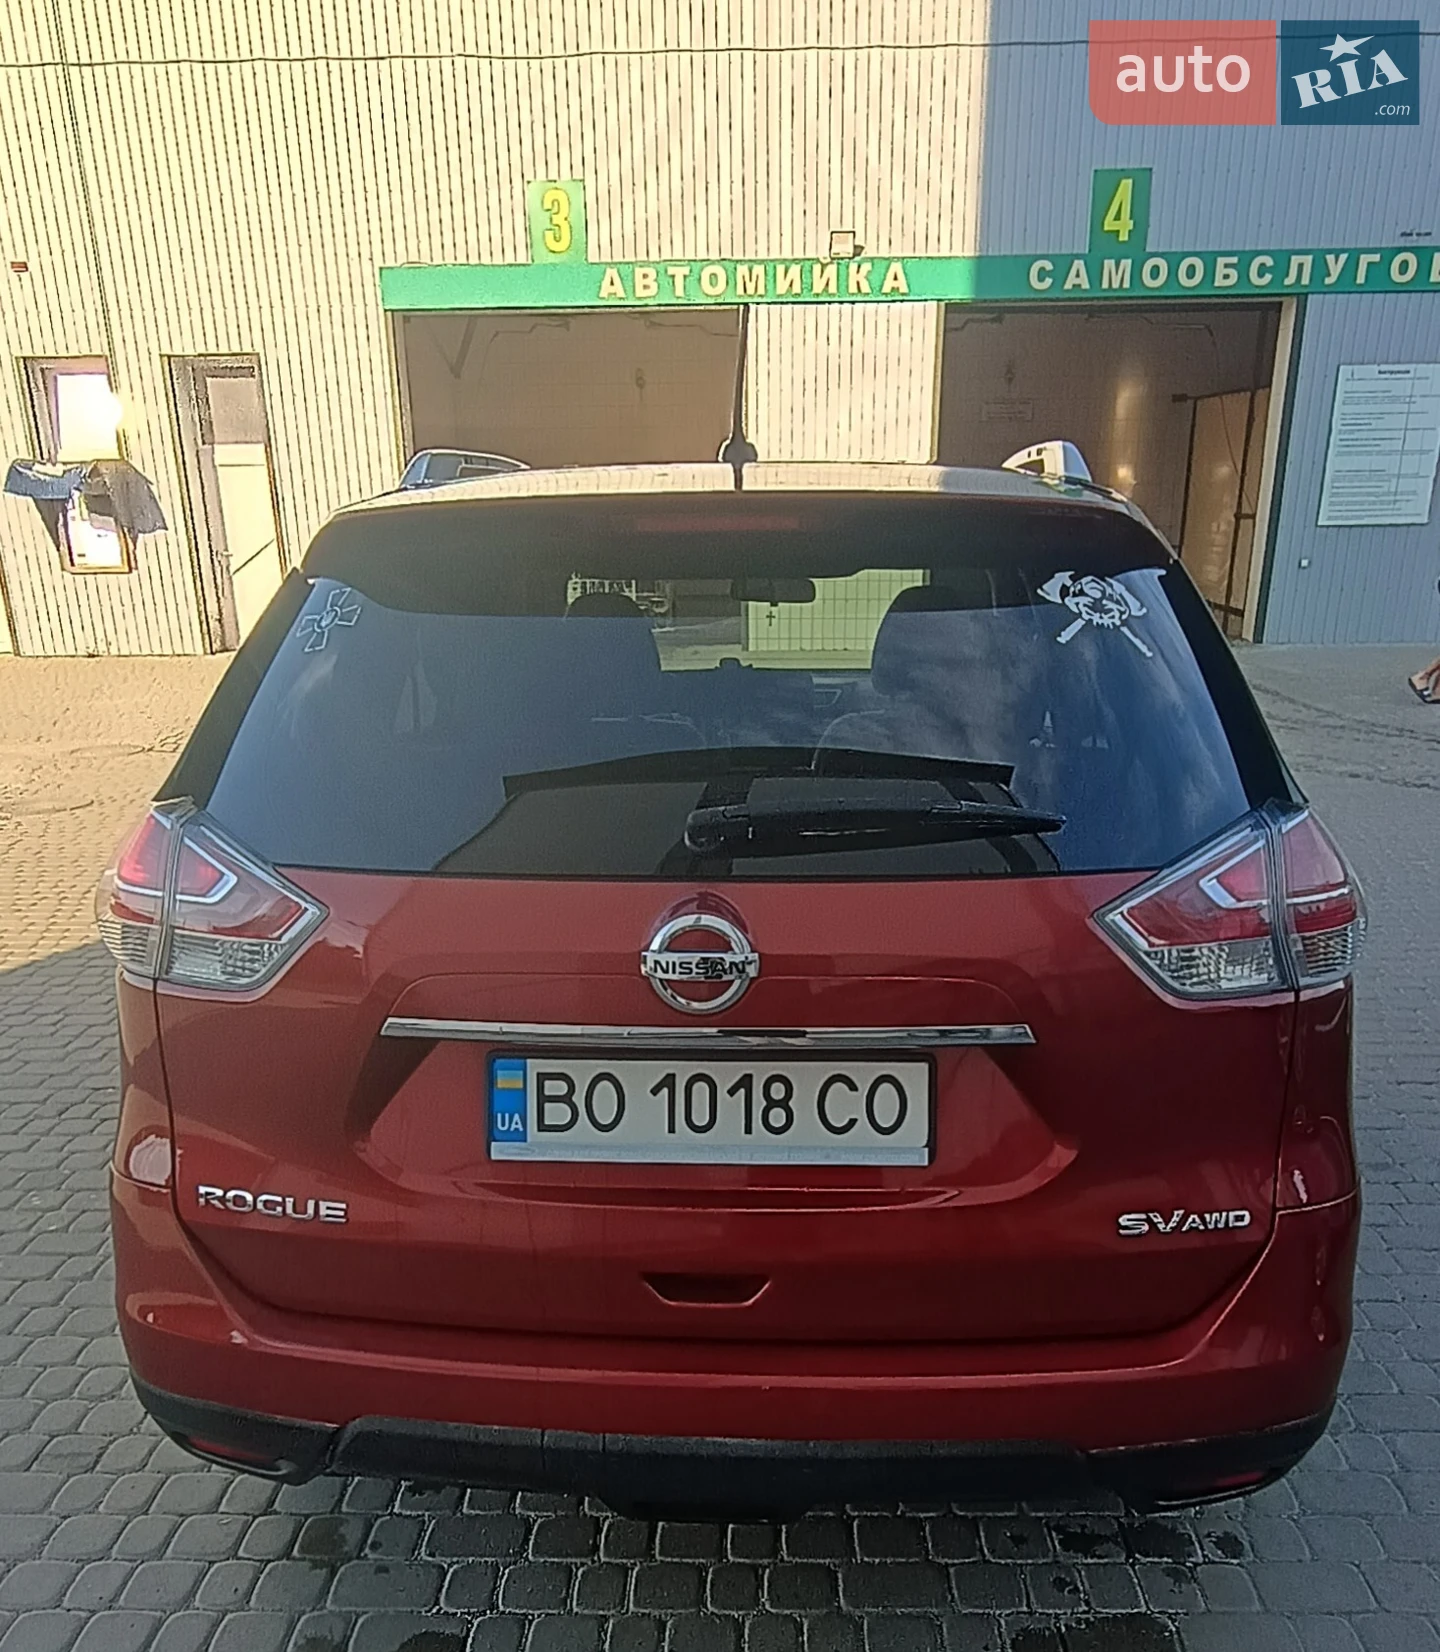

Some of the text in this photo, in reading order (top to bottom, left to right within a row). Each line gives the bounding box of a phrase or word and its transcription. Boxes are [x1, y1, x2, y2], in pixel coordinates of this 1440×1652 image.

[541, 187, 573, 254] 3
[1103, 178, 1134, 242] 4
[599, 258, 910, 299] АВТОМИЙКА
[653, 959, 746, 976] NISSAN
[497, 1113, 523, 1132] UA
[536, 1071, 909, 1136] BO 1018 CO
[197, 1185, 347, 1223] ROGUE
